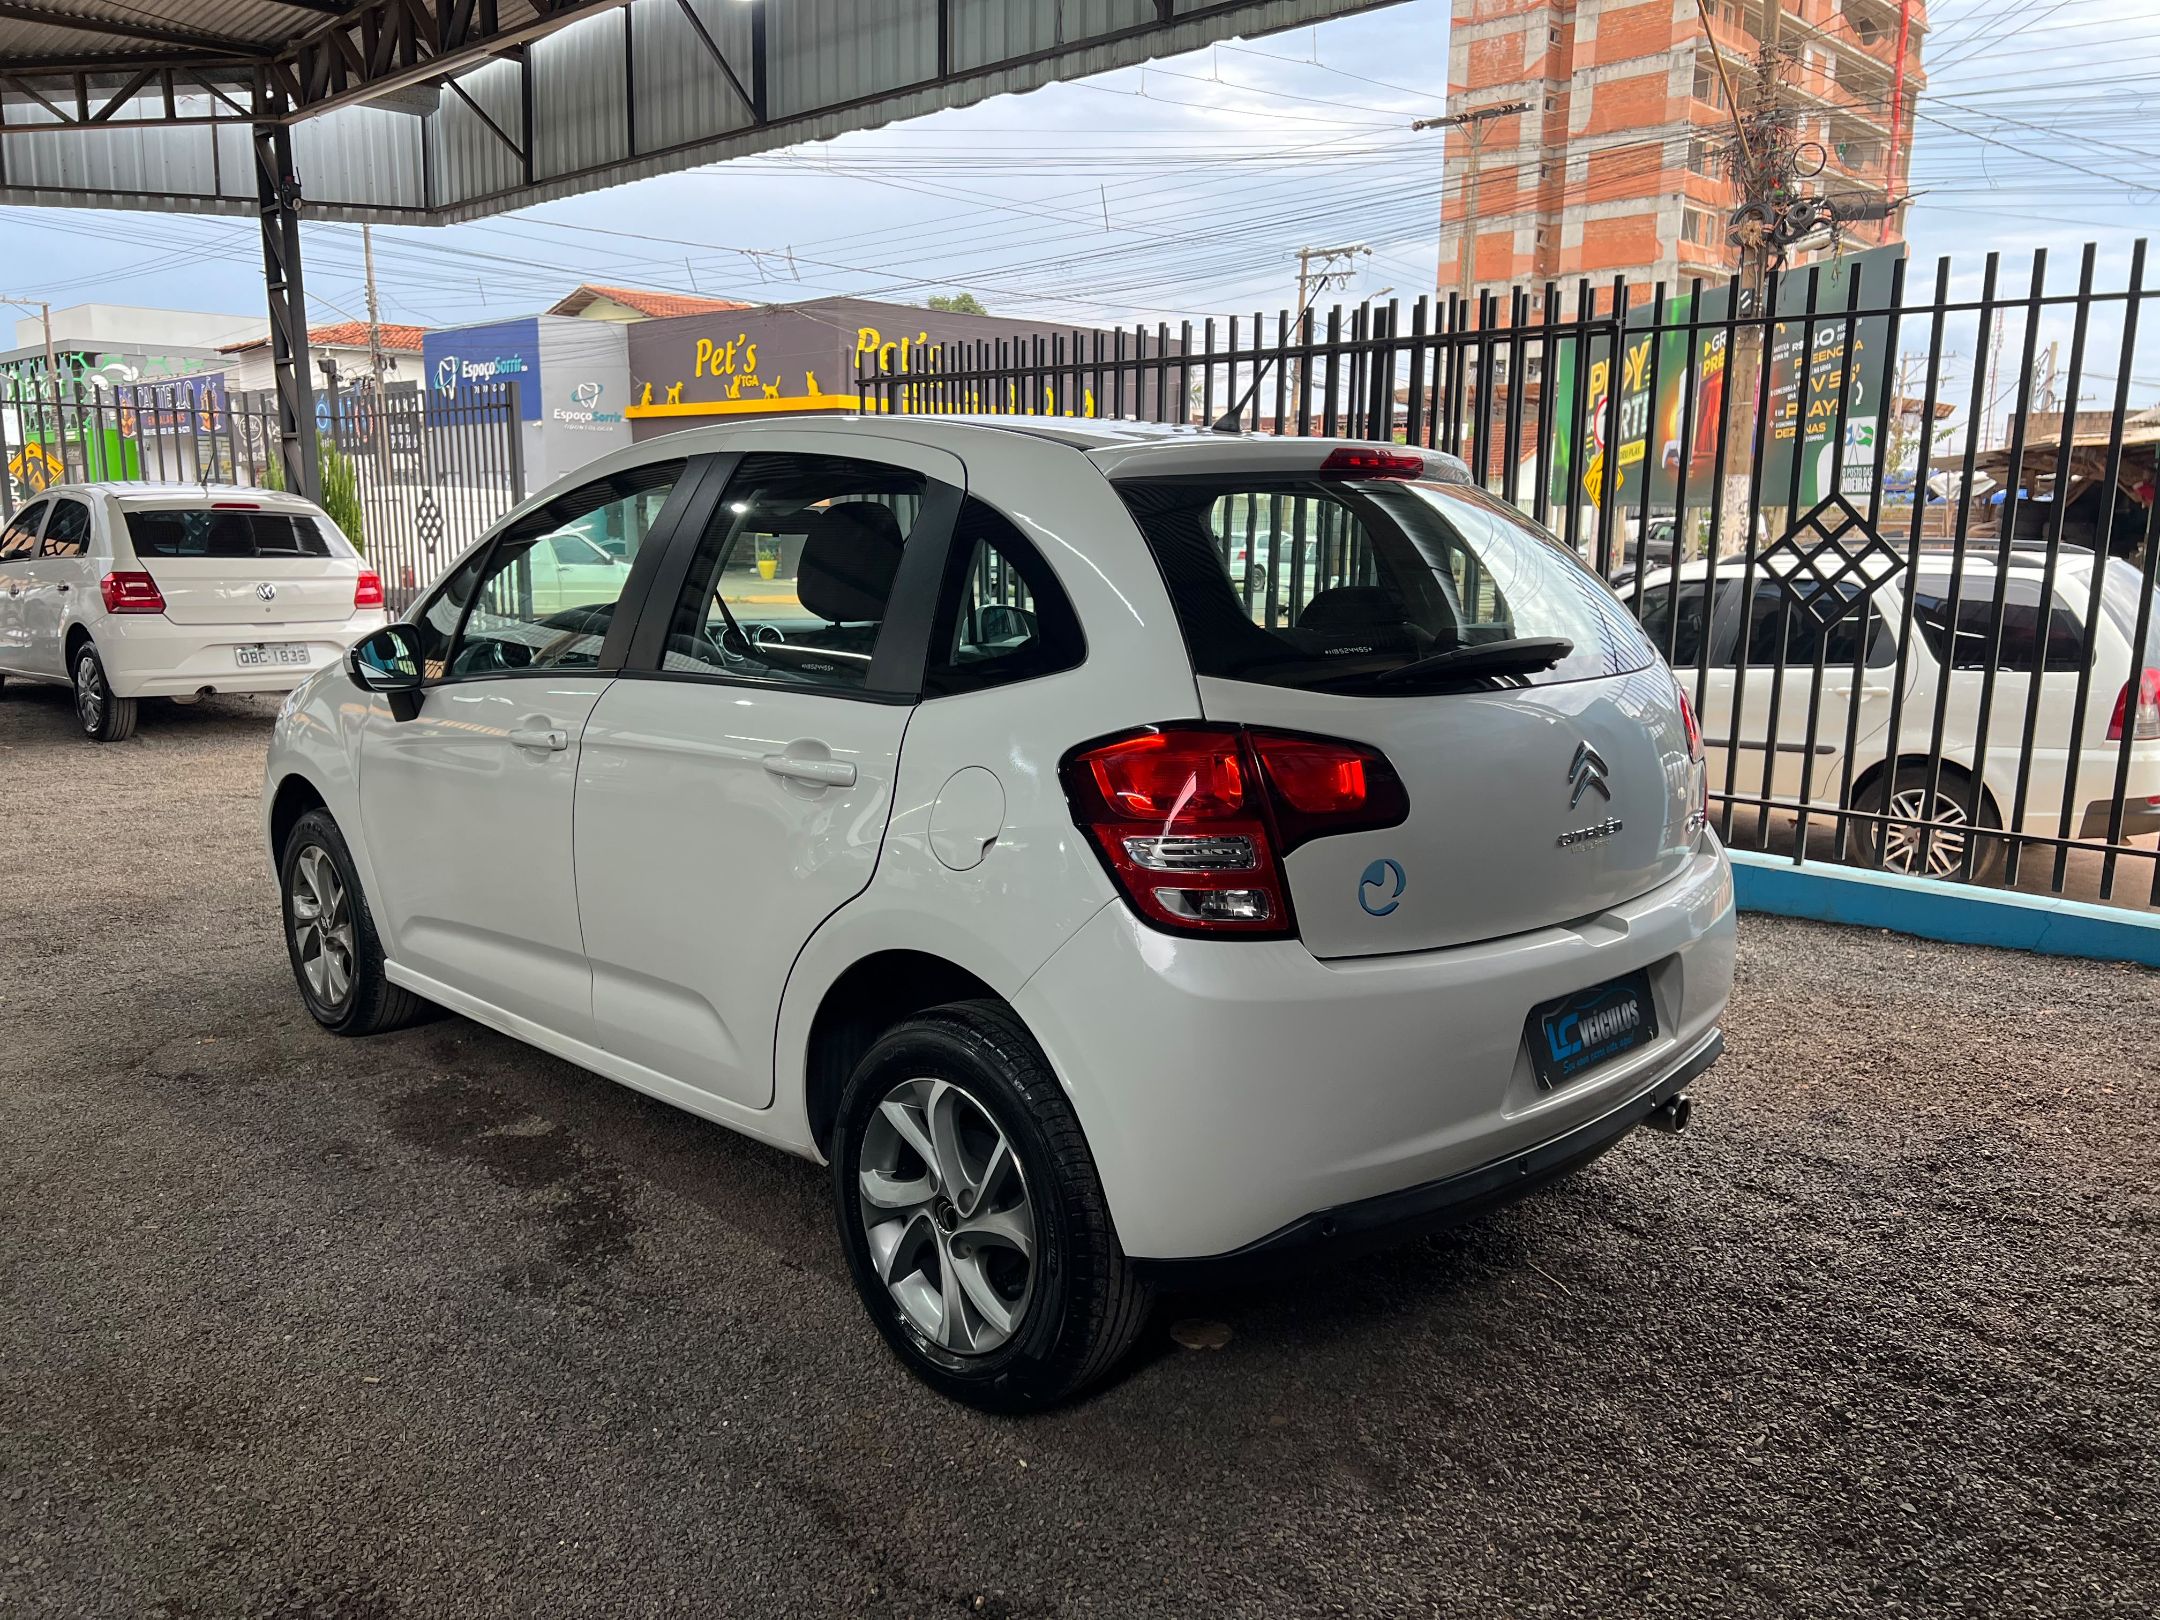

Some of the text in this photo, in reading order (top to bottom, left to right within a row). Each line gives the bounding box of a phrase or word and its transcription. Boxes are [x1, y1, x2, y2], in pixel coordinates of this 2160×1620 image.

[695, 333, 758, 378] Pet's
[1794, 340, 1864, 369] PEENCA
[741, 375, 759, 387] TGA
[137, 380, 194, 413] CATELO
[1785, 398, 1838, 419] PAY
[1775, 422, 1826, 439] DEZNAS
[1841, 477, 1872, 492] NDEIRAS
[1578, 1000, 1640, 1049] VEÍCULOS
